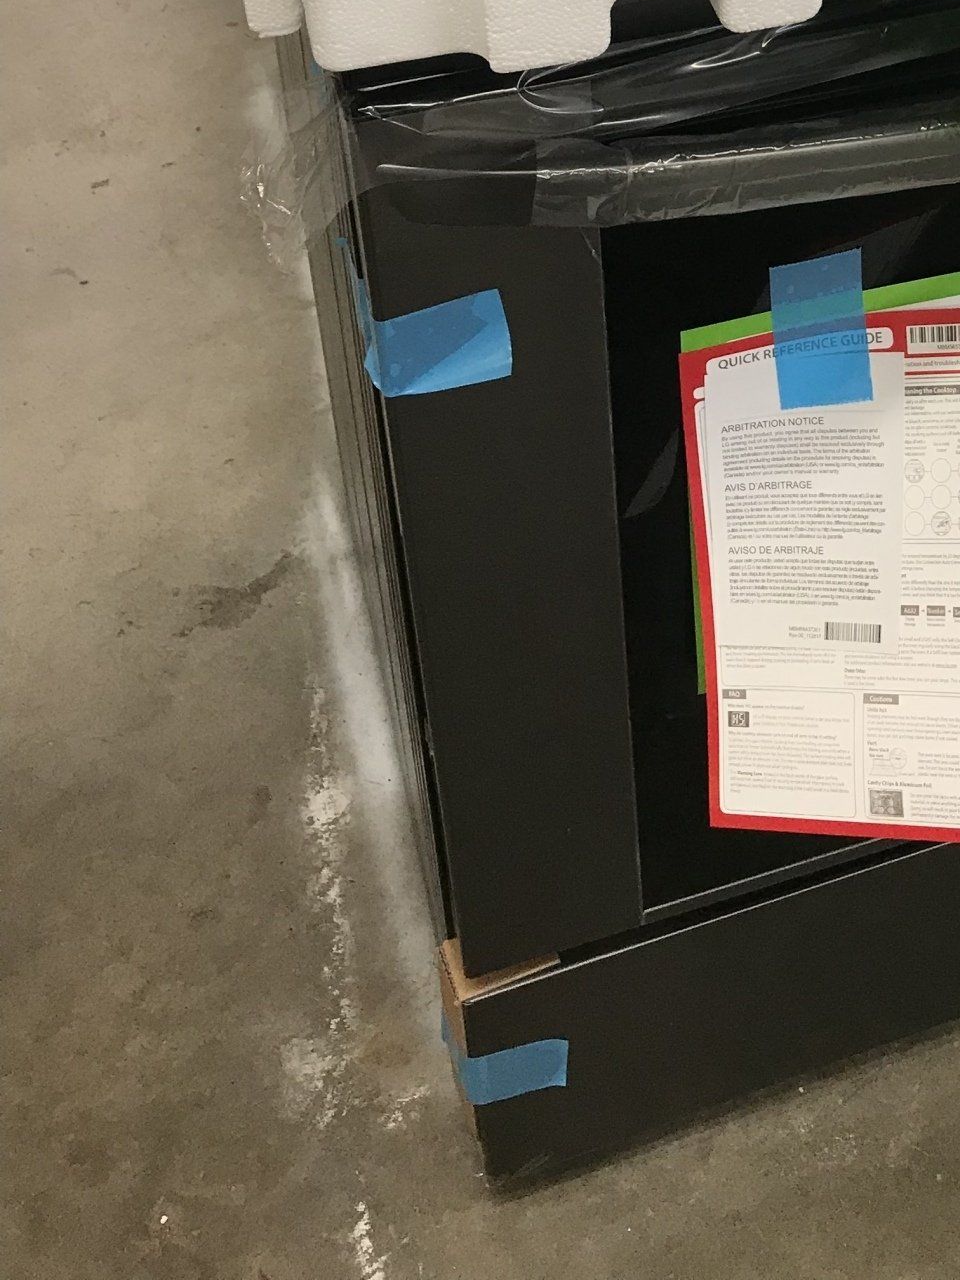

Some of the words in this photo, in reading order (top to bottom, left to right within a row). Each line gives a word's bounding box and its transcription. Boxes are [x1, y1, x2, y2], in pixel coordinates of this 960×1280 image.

[717, 350, 761, 370] QUICK
[763, 335, 838, 358] REFERENCE
[840, 331, 883, 347] GUIDE
[721, 419, 786, 433] ARBITRATION
[788, 416, 825, 426] NOTICE
[724, 482, 746, 492] AVIS
[728, 546, 757, 555] AVISO
[759, 546, 773, 555] DE
[774, 545, 825, 555] ARBITRAJE
